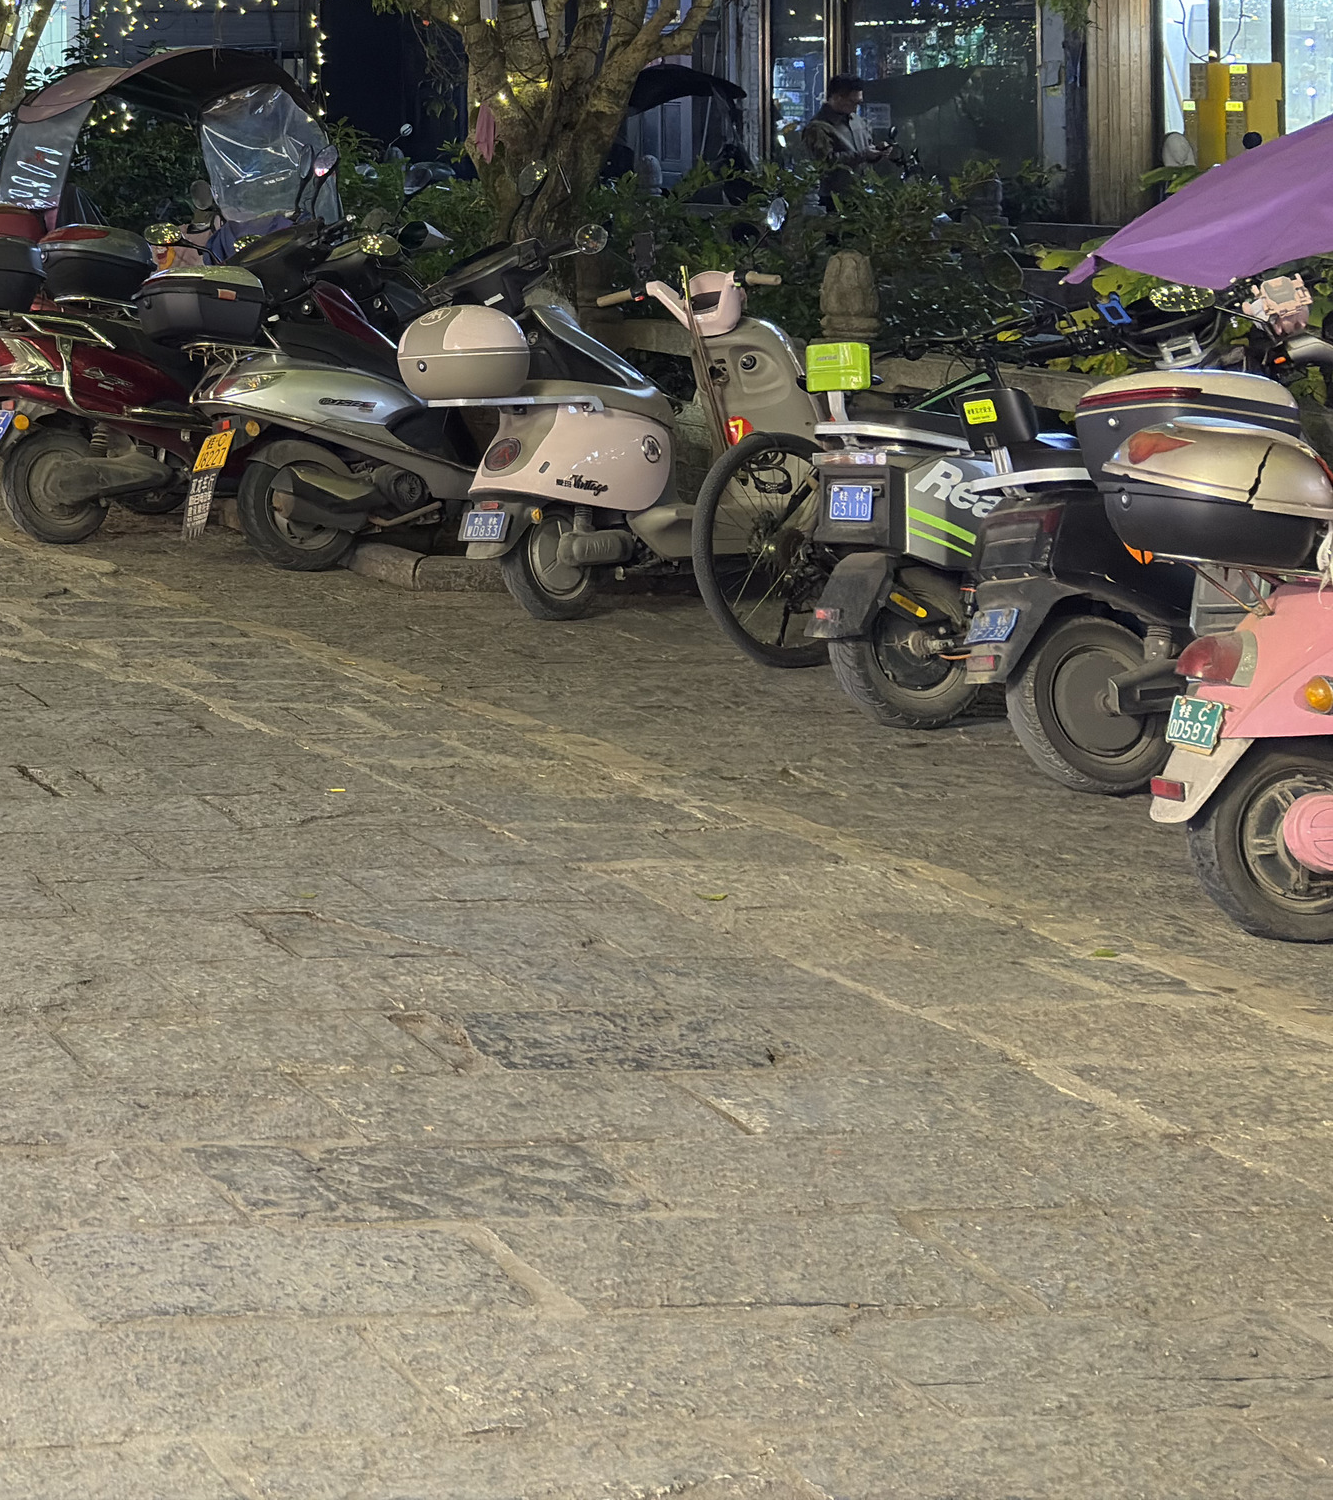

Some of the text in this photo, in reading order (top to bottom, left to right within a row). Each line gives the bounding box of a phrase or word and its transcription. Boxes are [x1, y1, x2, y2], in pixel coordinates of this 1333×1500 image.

[194, 447, 227, 469] J8227
[569, 474, 609, 497] Vintage
[833, 502, 869, 517] C3110
[1179, 704, 1211, 722] 桂 C
